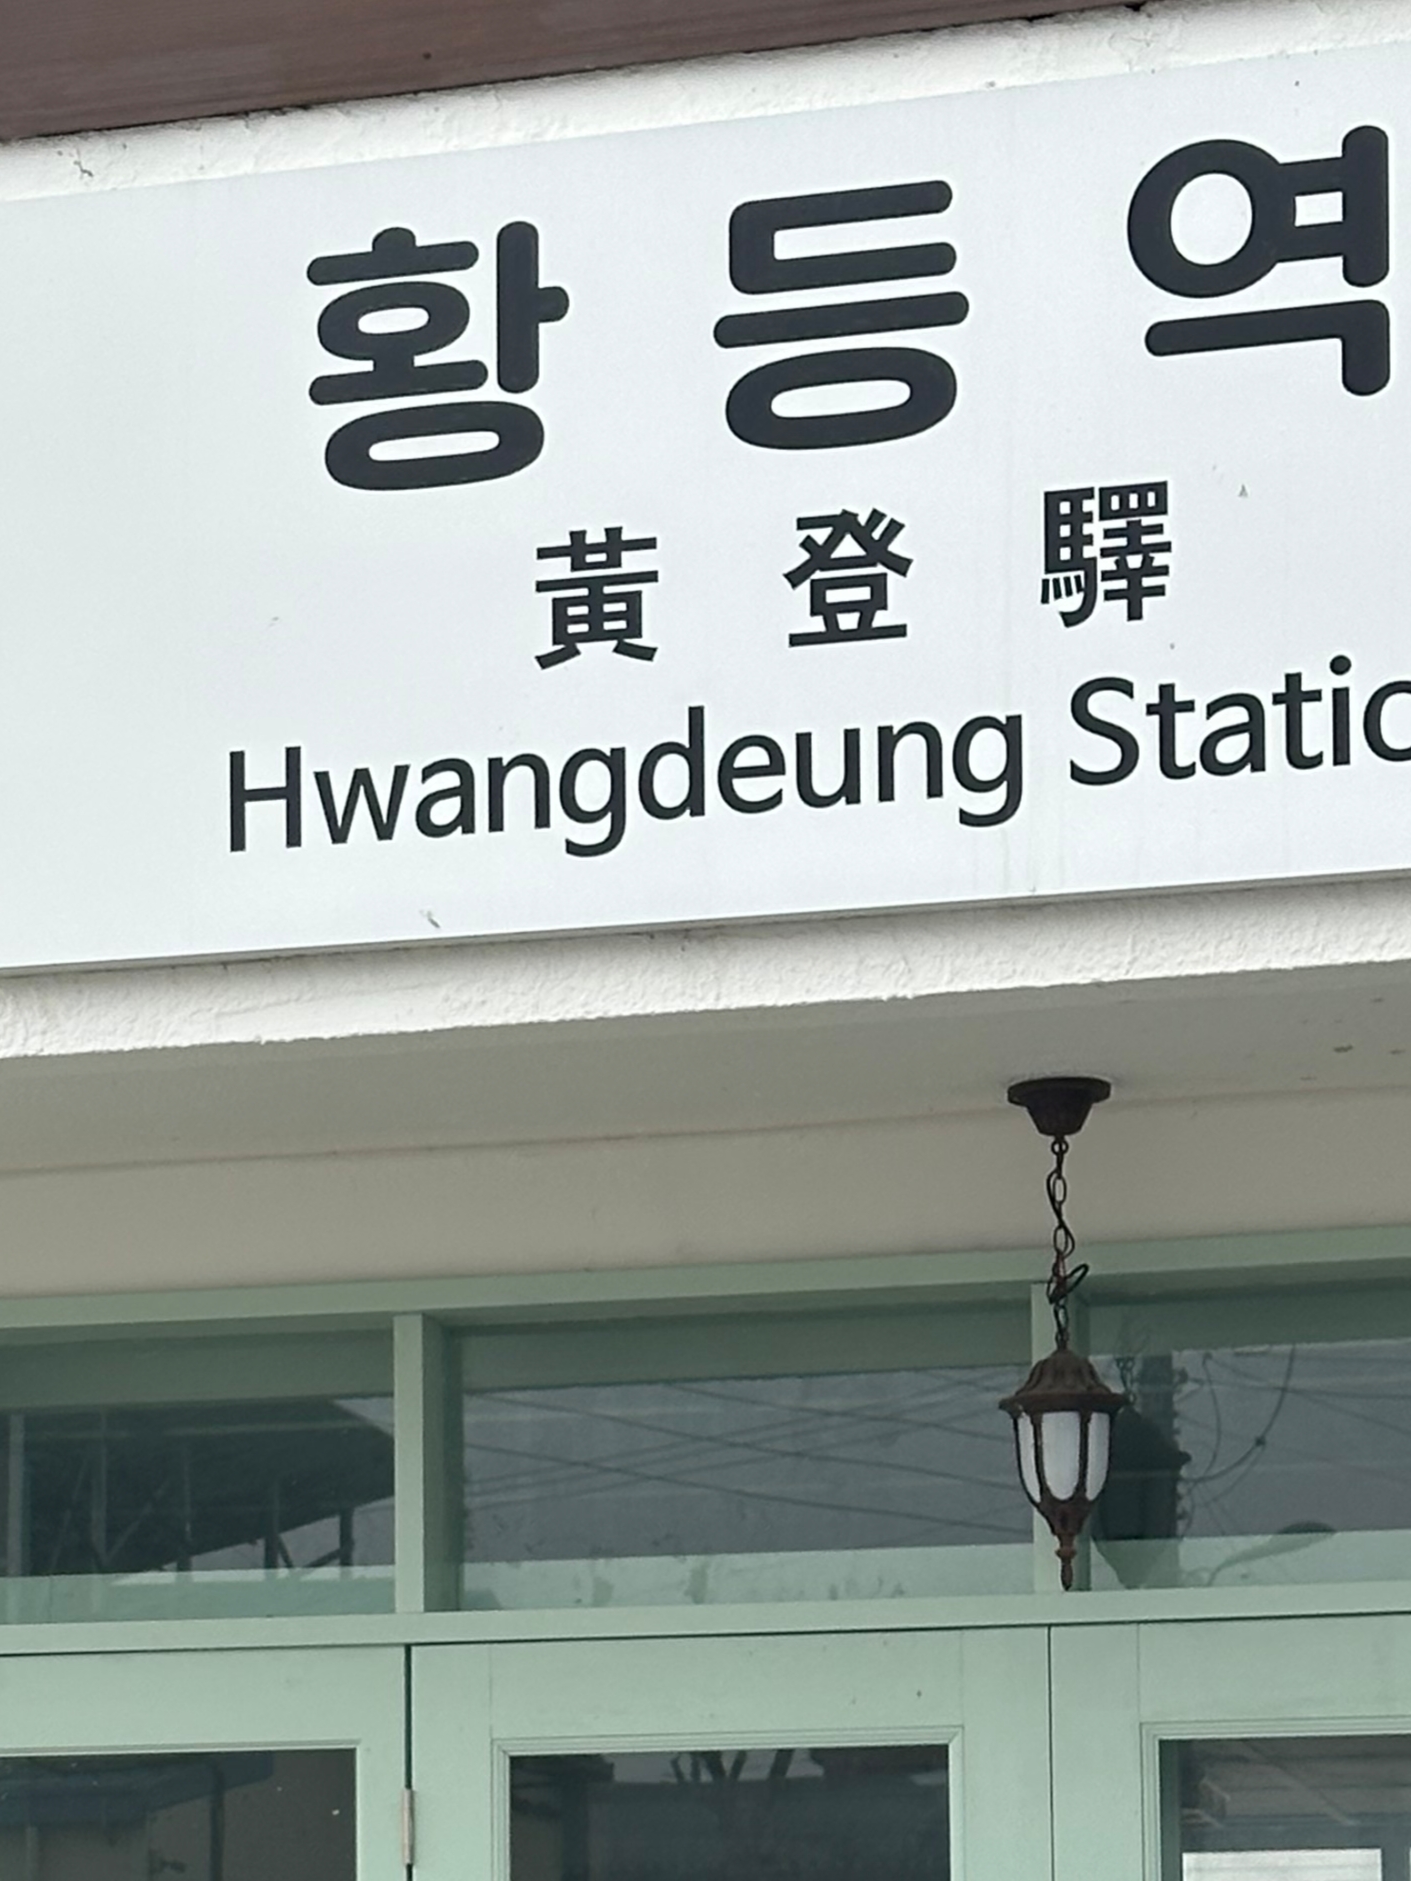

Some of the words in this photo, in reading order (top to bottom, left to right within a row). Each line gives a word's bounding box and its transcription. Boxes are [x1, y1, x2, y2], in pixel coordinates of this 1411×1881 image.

[306, 125, 1391, 491] 황등역
[534, 480, 1172, 670] 黃登驛
[229, 705, 1023, 858] Hwangdeung
